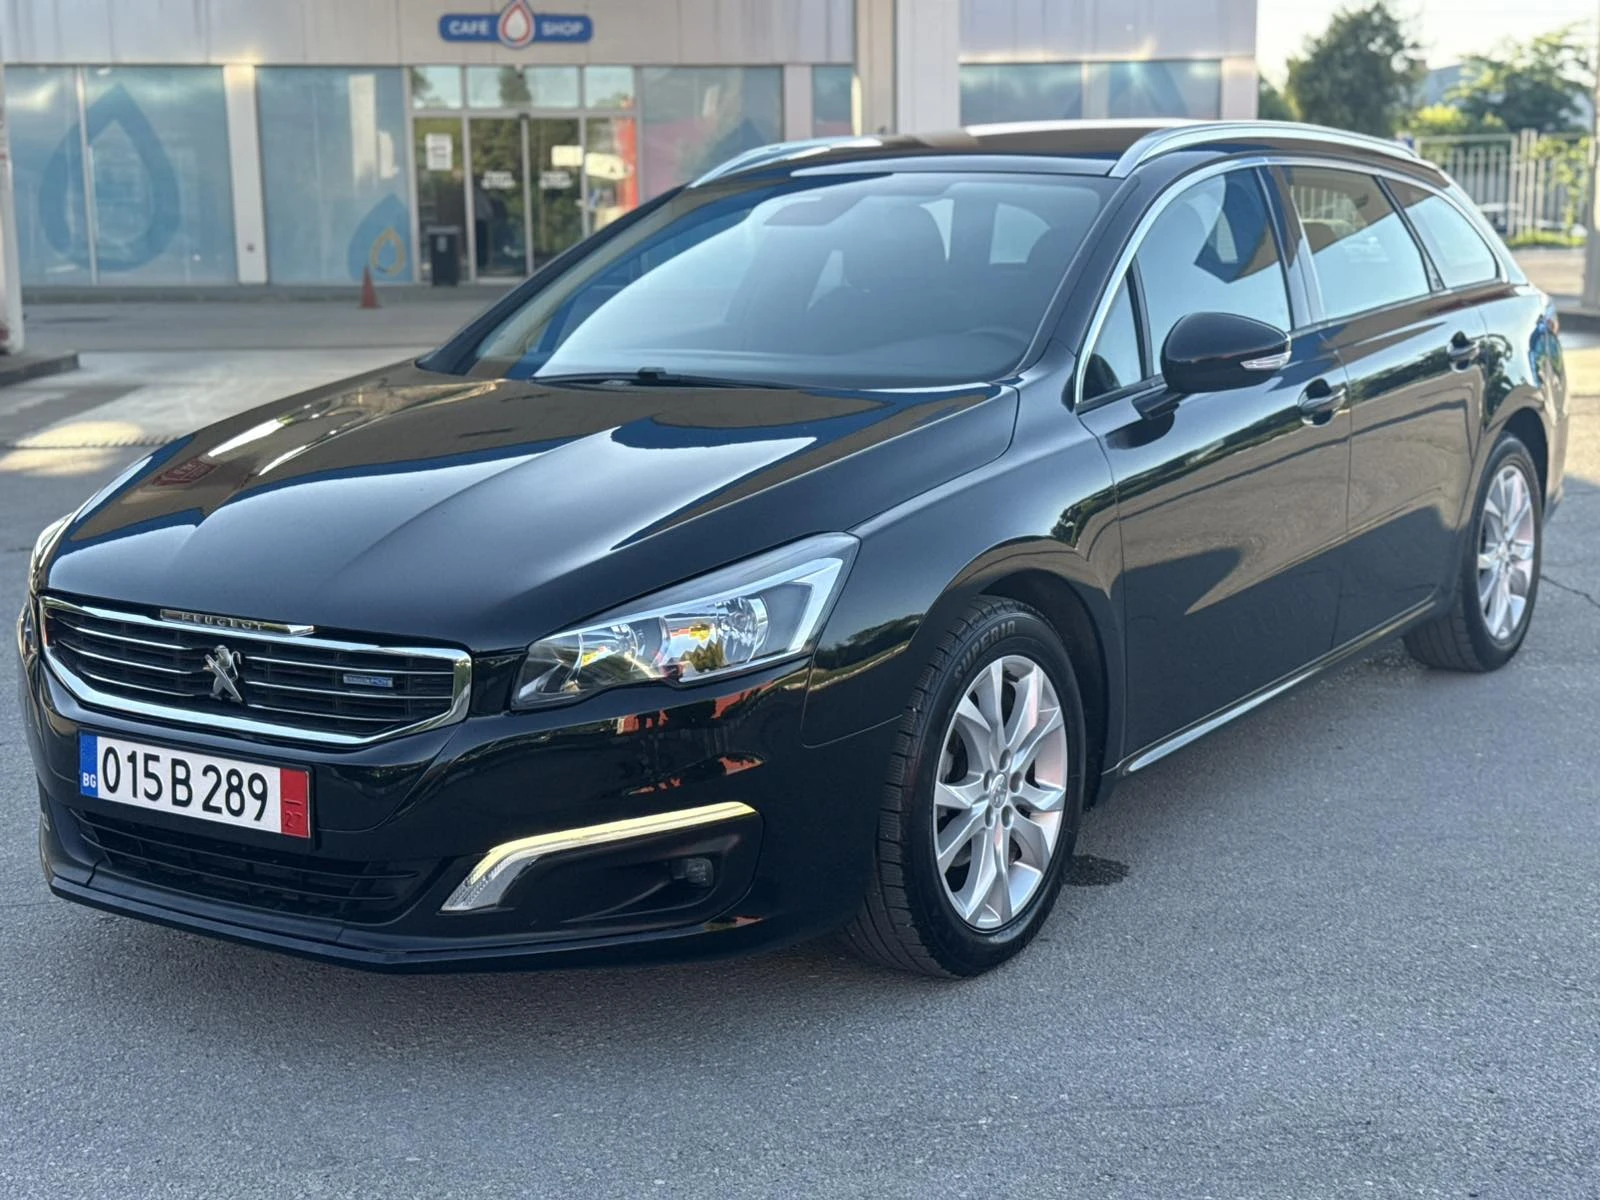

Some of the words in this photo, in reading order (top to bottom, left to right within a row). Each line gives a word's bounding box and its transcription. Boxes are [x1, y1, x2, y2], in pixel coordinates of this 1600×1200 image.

[541, 21, 584, 36] SHOP
[181, 612, 265, 631] PEUGEOT
[82, 773, 97, 788] BG
